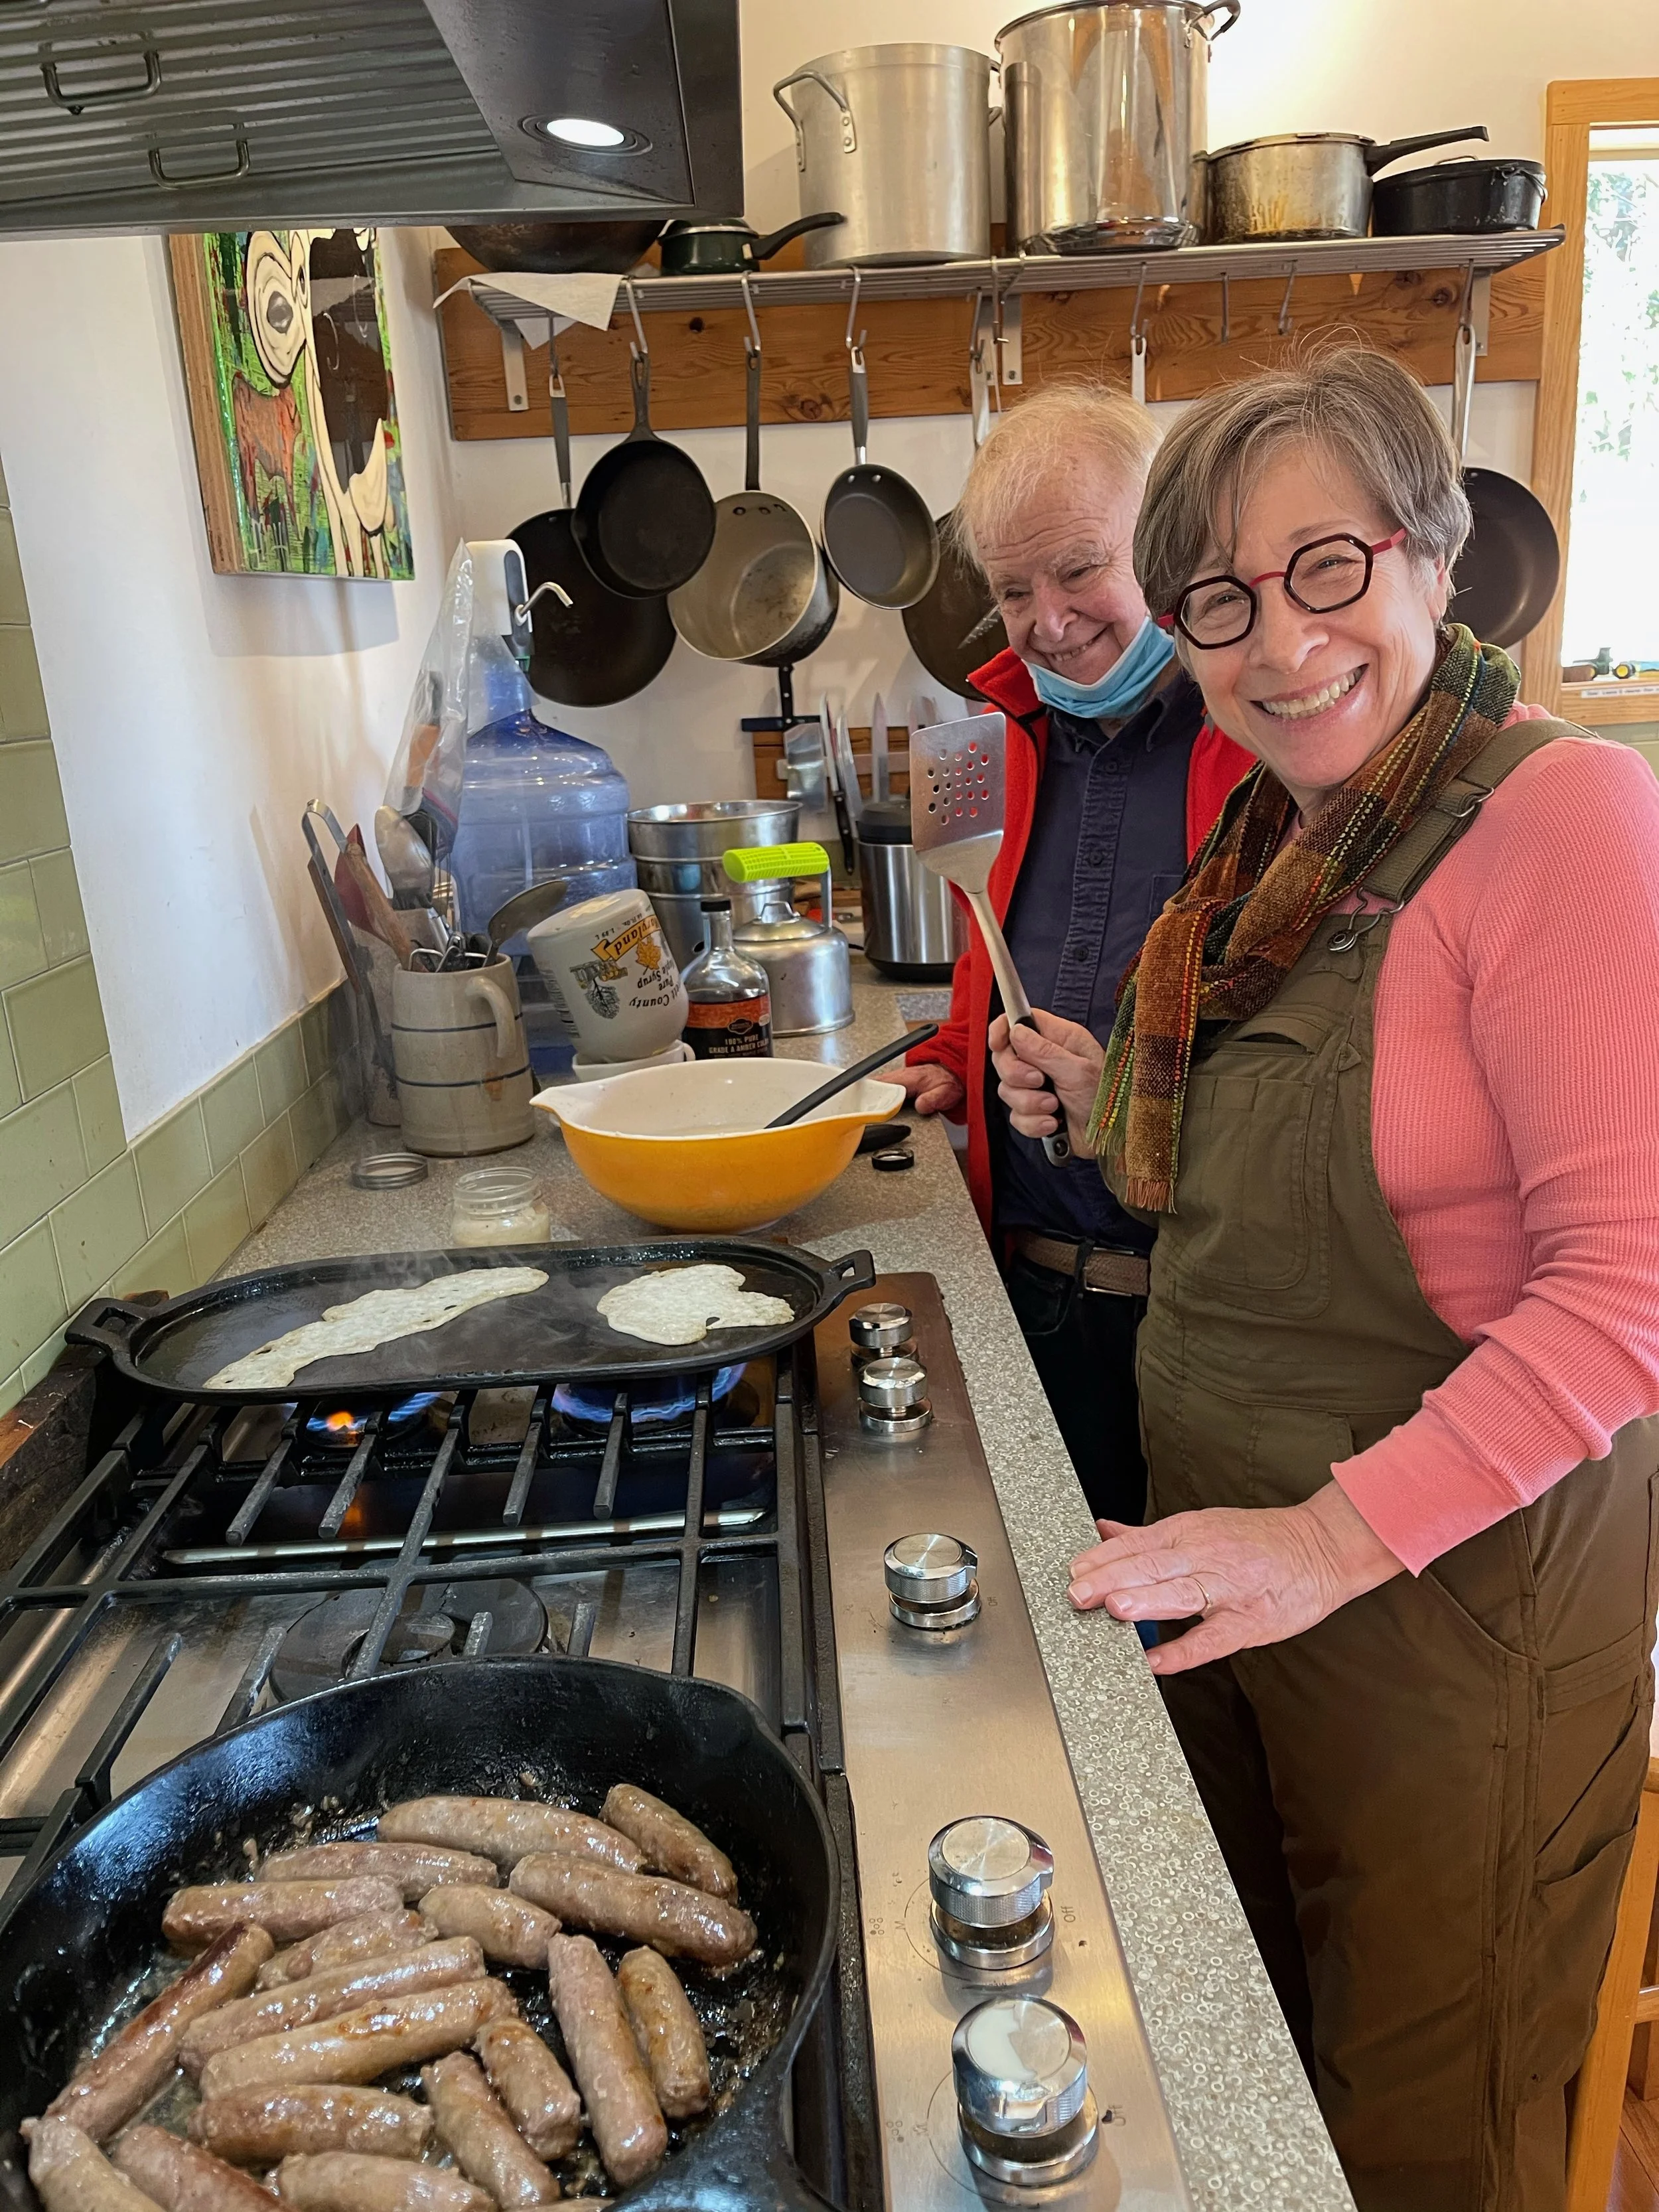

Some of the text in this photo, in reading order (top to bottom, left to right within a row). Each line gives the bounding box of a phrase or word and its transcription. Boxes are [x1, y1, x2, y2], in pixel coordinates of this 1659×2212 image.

[637, 970, 662, 989] Syrup
[659, 975, 674, 991] Pure
[629, 994, 670, 1009] County
[744, 1034, 758, 1043] PURE
[736, 1043, 756, 1052] AMBER
[1060, 1905, 1076, 1923] Off
